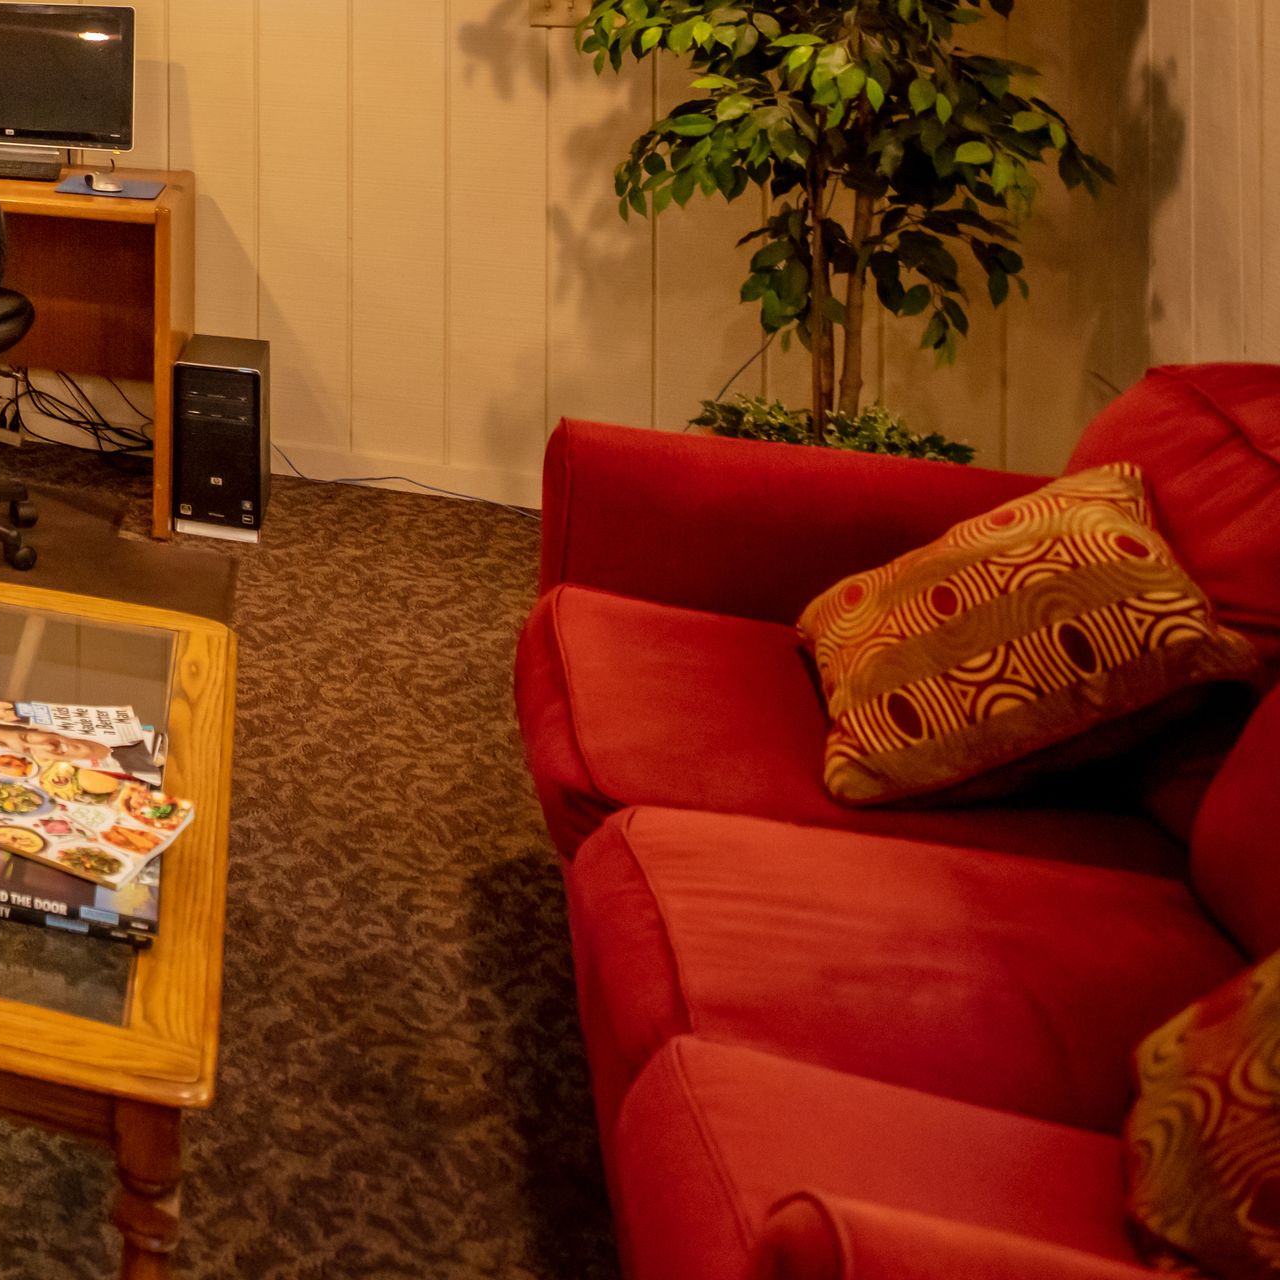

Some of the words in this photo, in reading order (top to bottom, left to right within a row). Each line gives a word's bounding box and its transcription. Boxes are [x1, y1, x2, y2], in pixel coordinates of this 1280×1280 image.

[54, 706, 72, 720] Kids
[72, 707, 88, 719] Me
[96, 709, 114, 730] Better
[113, 710, 131, 724] Man
[78, 718, 96, 736] Made
[10, 892, 32, 908] THE
[34, 897, 68, 916] DOOR
